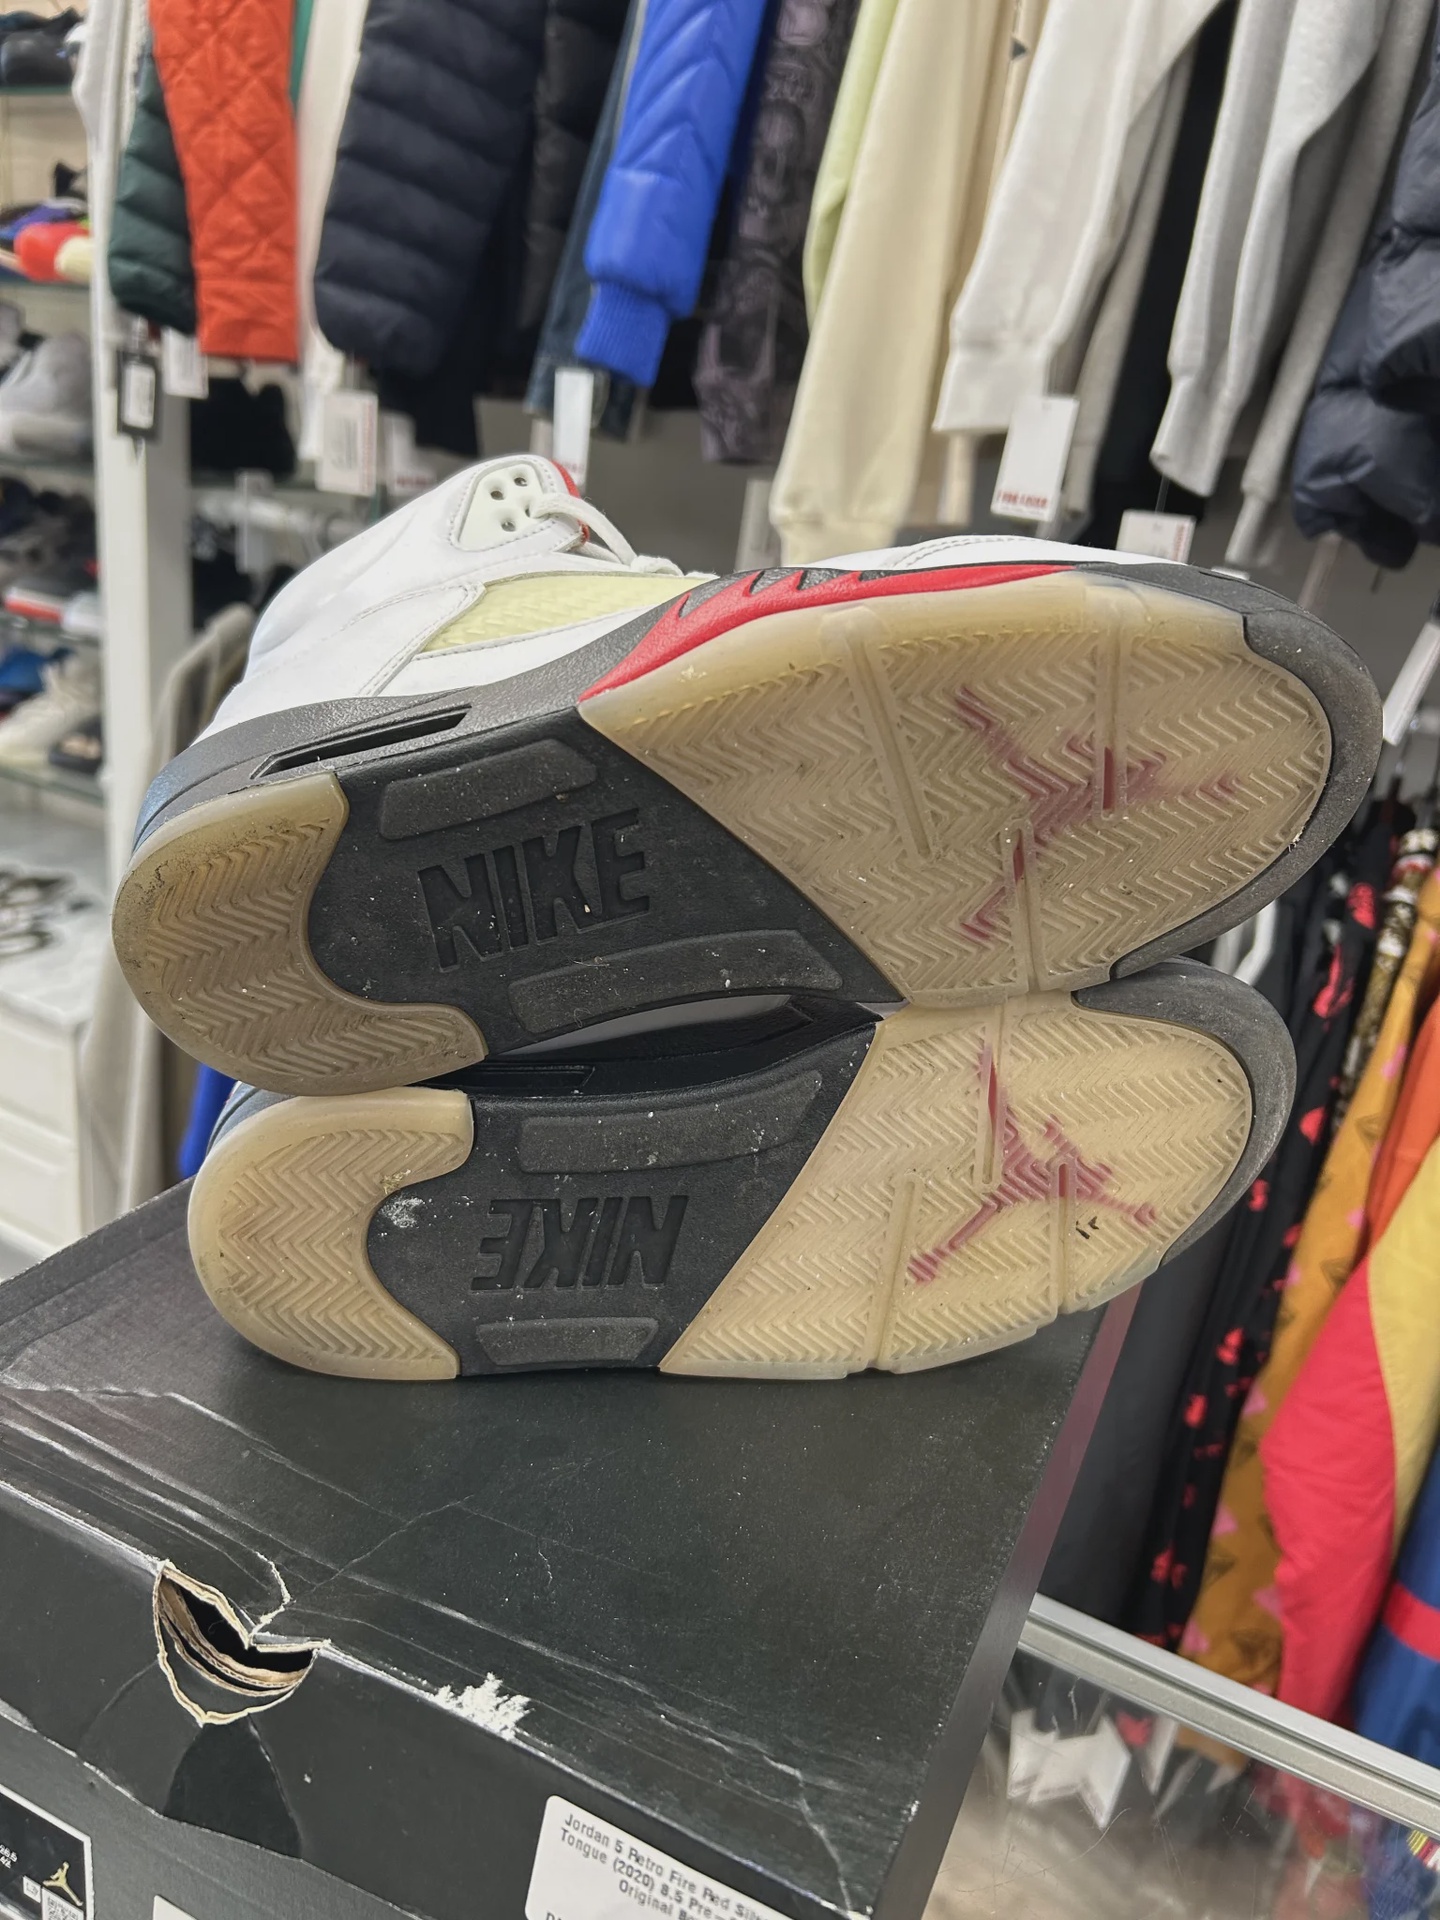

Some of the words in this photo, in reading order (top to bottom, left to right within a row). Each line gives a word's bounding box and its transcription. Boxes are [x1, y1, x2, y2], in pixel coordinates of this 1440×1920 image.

[417, 807, 651, 974] NIKE
[470, 1195, 689, 1290] NIKE
[560, 1827, 608, 1865] Tongue
[613, 1857, 655, 1892] (2020)
[660, 1883, 684, 1904] 8.5
[564, 1813, 611, 1848] Jordan
[614, 1839, 625, 1854] 5
[628, 1846, 664, 1877] Retro
[669, 1870, 697, 1895] Fire
[702, 1887, 731, 1911] Red
[619, 1879, 674, 1915] Original
